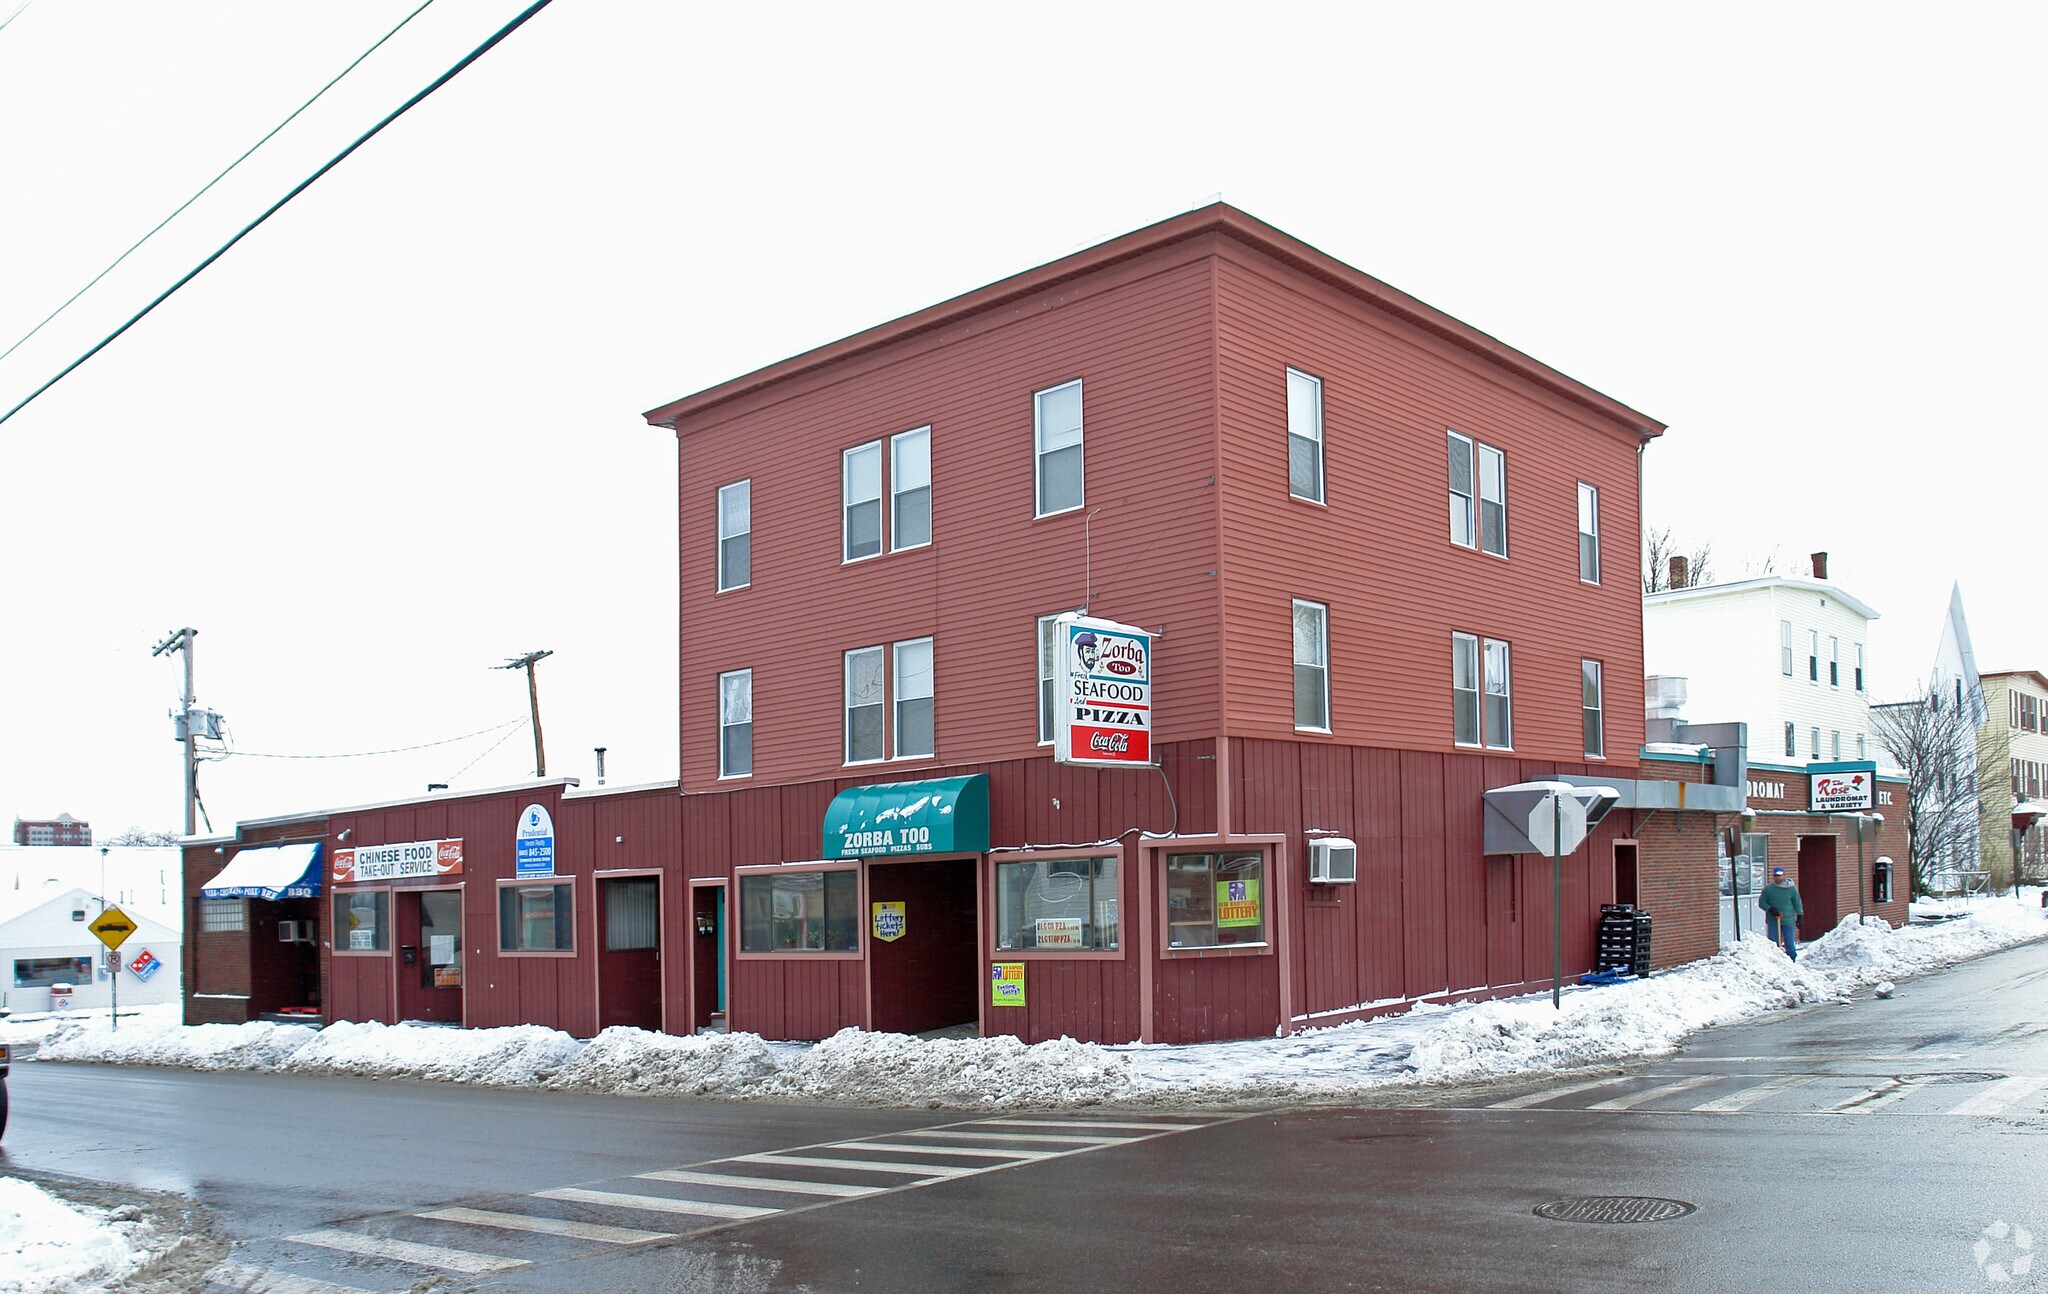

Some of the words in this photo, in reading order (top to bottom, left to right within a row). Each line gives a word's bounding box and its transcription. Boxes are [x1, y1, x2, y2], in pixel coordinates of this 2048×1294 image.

[1101, 637, 1144, 664] Zorba
[1112, 662, 1131, 673] Too
[1074, 680, 1143, 701] SEAFOOD
[1075, 707, 1145, 725] PIZZA
[1090, 731, 1129, 752] Coca-Cola
[1817, 778, 1849, 796] Rose
[1815, 795, 1868, 803] LAUNDROMAT
[522, 828, 548, 837] Prudential
[844, 830, 893, 849] ZORBA
[900, 826, 929, 844] TOO
[360, 849, 399, 864] CHINESE
[404, 846, 432, 861] FOOD
[438, 845, 461, 860] Coca-Cola
[841, 848, 859, 856] FRESH
[861, 846, 886, 855] SEAFOOD
[890, 844, 911, 852] PIZZAS
[916, 843, 933, 851] SUBS
[334, 856, 353, 870] Coca-Cola
[360, 863, 394, 877] TAKE-OUT
[400, 860, 432, 874] SERVICE
[288, 887, 312, 898] BBQ
[875, 913, 904, 923] Lottery
[1218, 906, 1258, 920] LOTTERY
[880, 929, 900, 938] Here!
[1003, 970, 1023, 980] LOTTERY
